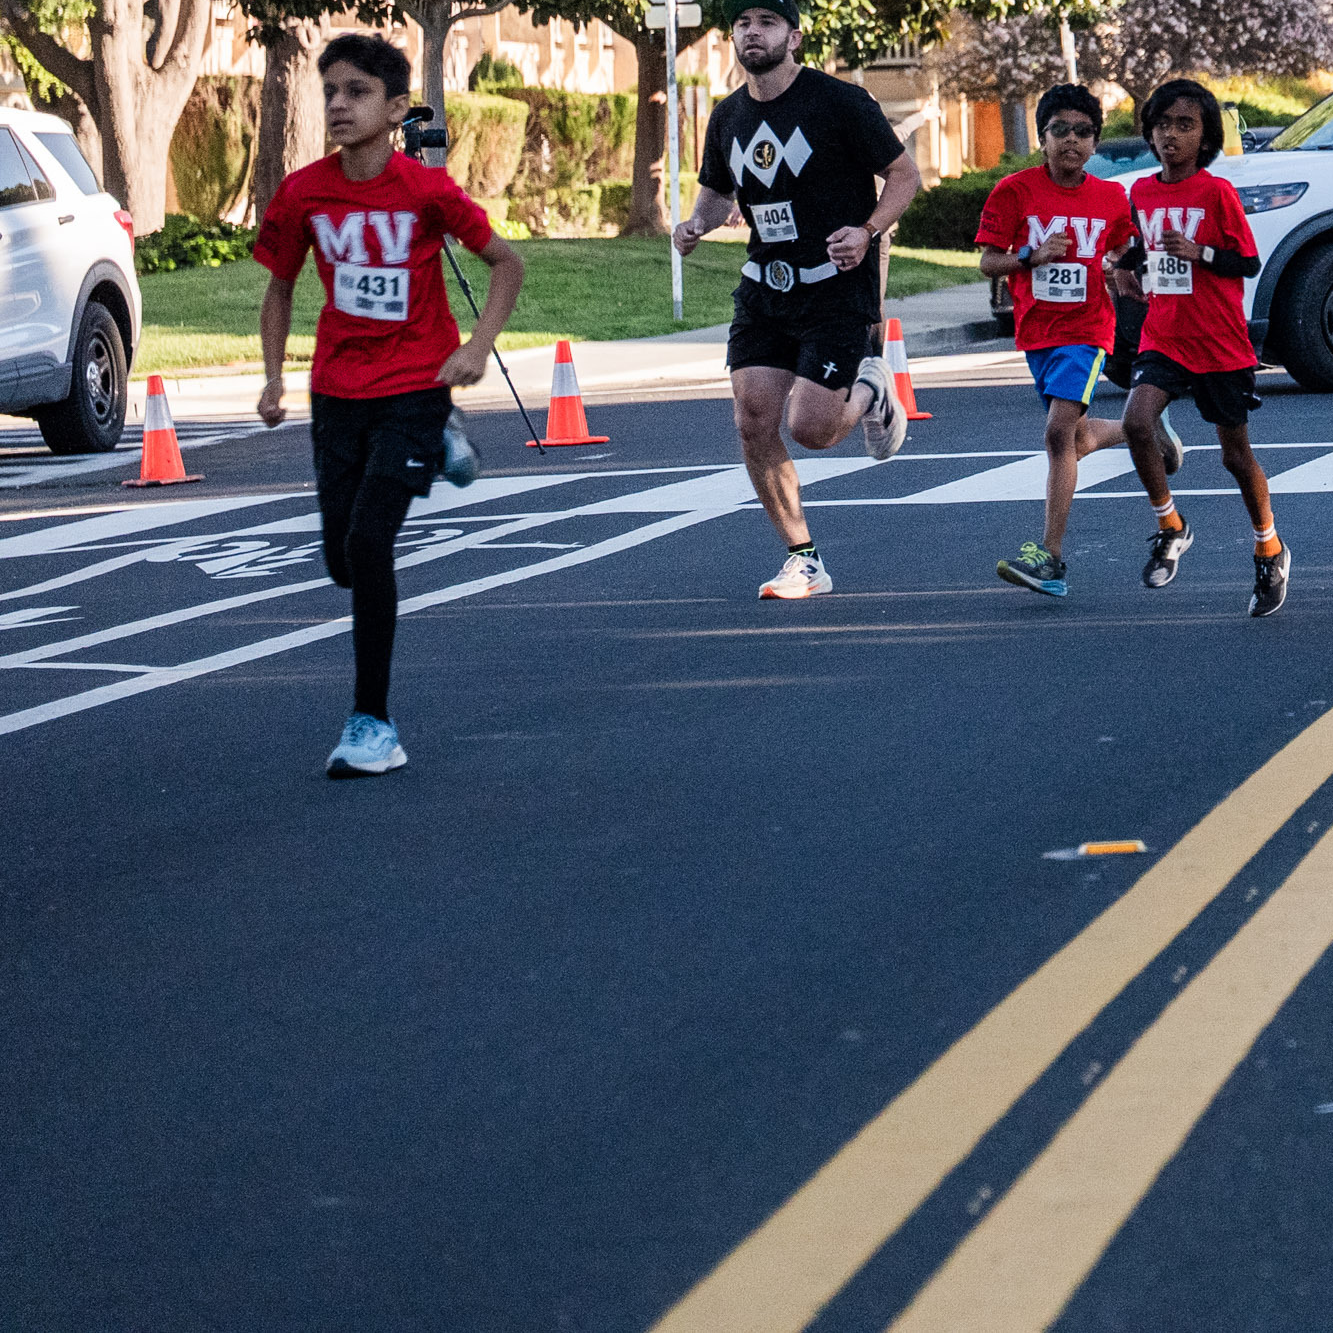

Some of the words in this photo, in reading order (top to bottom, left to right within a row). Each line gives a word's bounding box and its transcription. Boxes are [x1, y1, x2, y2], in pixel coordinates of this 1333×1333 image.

[764, 207, 790, 226] 404
[310, 210, 418, 265] MV
[1026, 215, 1107, 258] MV
[1137, 206, 1206, 254] MV
[1048, 268, 1081, 285] 281
[1157, 257, 1188, 275] 486
[356, 274, 400, 297] 431
